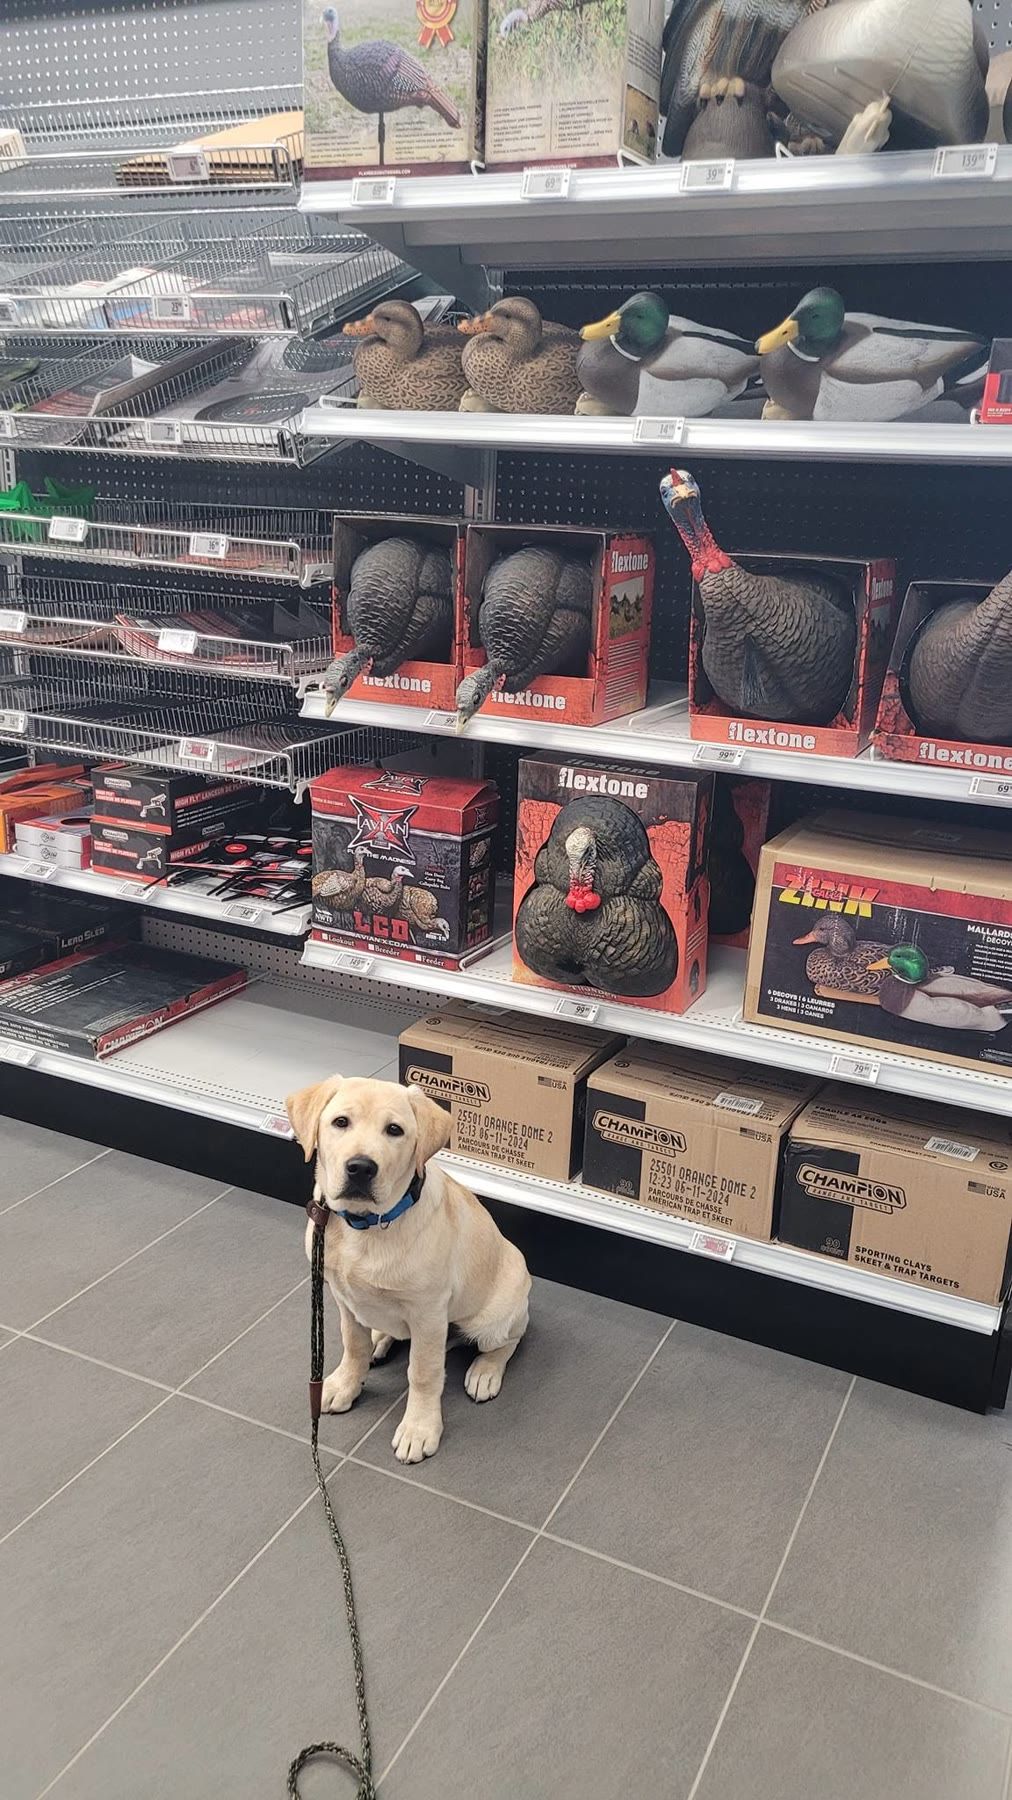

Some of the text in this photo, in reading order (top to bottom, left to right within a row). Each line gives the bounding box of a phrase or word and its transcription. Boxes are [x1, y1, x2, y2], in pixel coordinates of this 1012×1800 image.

[612, 551, 649, 573] flextone
[872, 577, 893, 599] flextone
[728, 722, 816, 750] flextone
[719, 751, 729, 759] 99
[919, 742, 1012, 770] flextone
[202, 788, 225, 800] LANCEUR
[557, 767, 648, 799] flextone
[998, 784, 1009, 793] 69
[361, 818, 406, 835] AVIAN
[380, 855, 417, 866] MADNESS
[778, 874, 880, 918] ZINK
[61, 927, 105, 948] LEAD SLED
[353, 911, 409, 942] LCD
[327, 933, 355, 947] Lookout
[374, 944, 400, 957] Breeder
[986, 936, 1012, 946] DECOY
[422, 954, 445, 968] Feeder
[575, 1005, 585, 1015] 99
[772, 991, 798, 1001] DECOYS
[807, 997, 836, 1008] LEURRES
[774, 997, 797, 1007] DRAKES
[806, 1003, 834, 1014] CANARDS
[781, 1005, 796, 1014] HENS
[805, 1010, 825, 1019] CANES
[853, 1064, 864, 1073] 79
[410, 1070, 487, 1099] CHAMPION
[551, 1081, 567, 1091] USA
[455, 1095, 477, 1105] TARGET
[457, 1109, 554, 1143] 25501 ORANGE DOME 2
[815, 1105, 851, 1116] FRAGILE
[864, 1115, 887, 1125] EGGS
[456, 1121, 529, 1150] 12:13 06-11-2024
[597, 1115, 683, 1149] CHAMPION
[606, 1132, 672, 1154] RANGE AND TARGET
[755, 1134, 773, 1144] USA
[457, 1136, 525, 1159] PARCOURS DE CHASSE
[457, 1143, 535, 1169] AMERICAN TRAP ET SKEET
[648, 1172, 730, 1207] 12:23 06-11-2024
[650, 1158, 757, 1200] 25501 ORANGE DOME 2
[802, 1169, 903, 1205] CHAMPION
[648, 1187, 723, 1215] PARCOURS DE CHASSE
[812, 1187, 889, 1212] RANGE AND TARGET
[986, 1188, 1006, 1200] USA
[647, 1195, 734, 1226] AMERICAN TRAP ET SKEET
[855, 1245, 932, 1272] SPORTING CLAYS
[854, 1254, 960, 1289] SKEET & TRAP TARGETS
